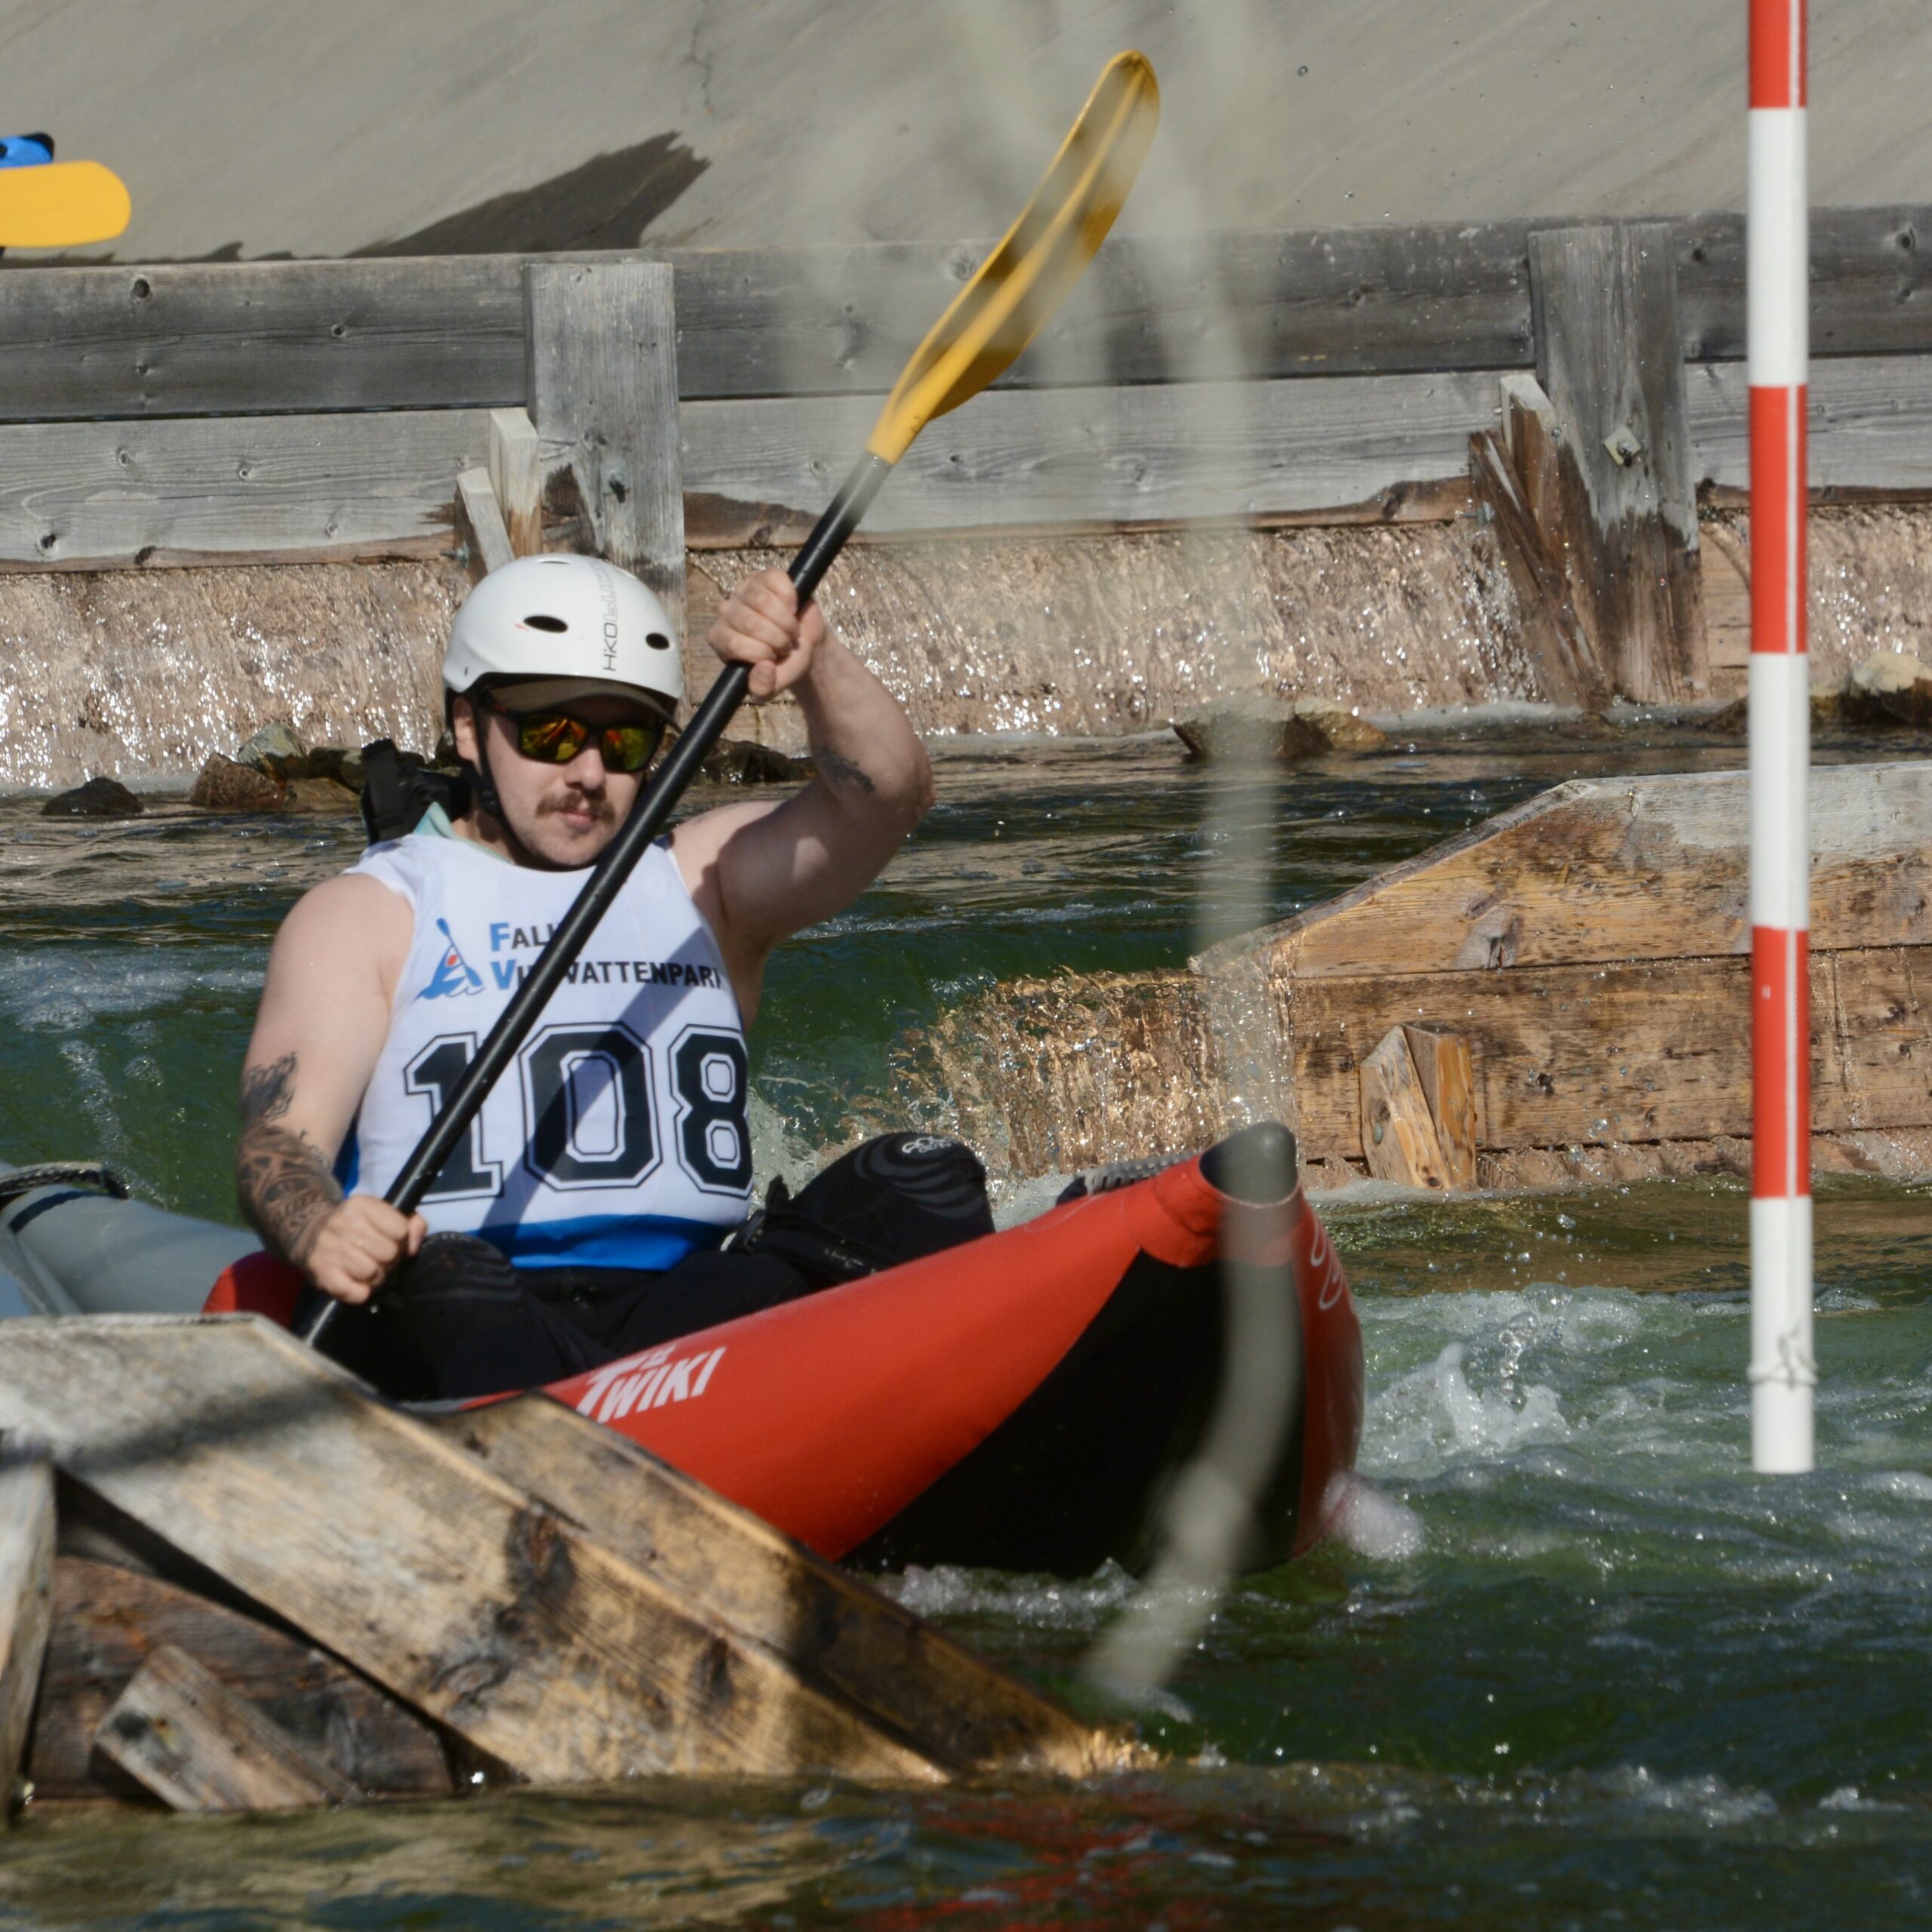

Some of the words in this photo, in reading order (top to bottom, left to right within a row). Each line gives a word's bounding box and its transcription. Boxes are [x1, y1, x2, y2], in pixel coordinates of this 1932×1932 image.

[489, 921, 560, 952] FAL
[404, 1021, 753, 1204] 108
[576, 1346, 728, 1424] TWIKI
